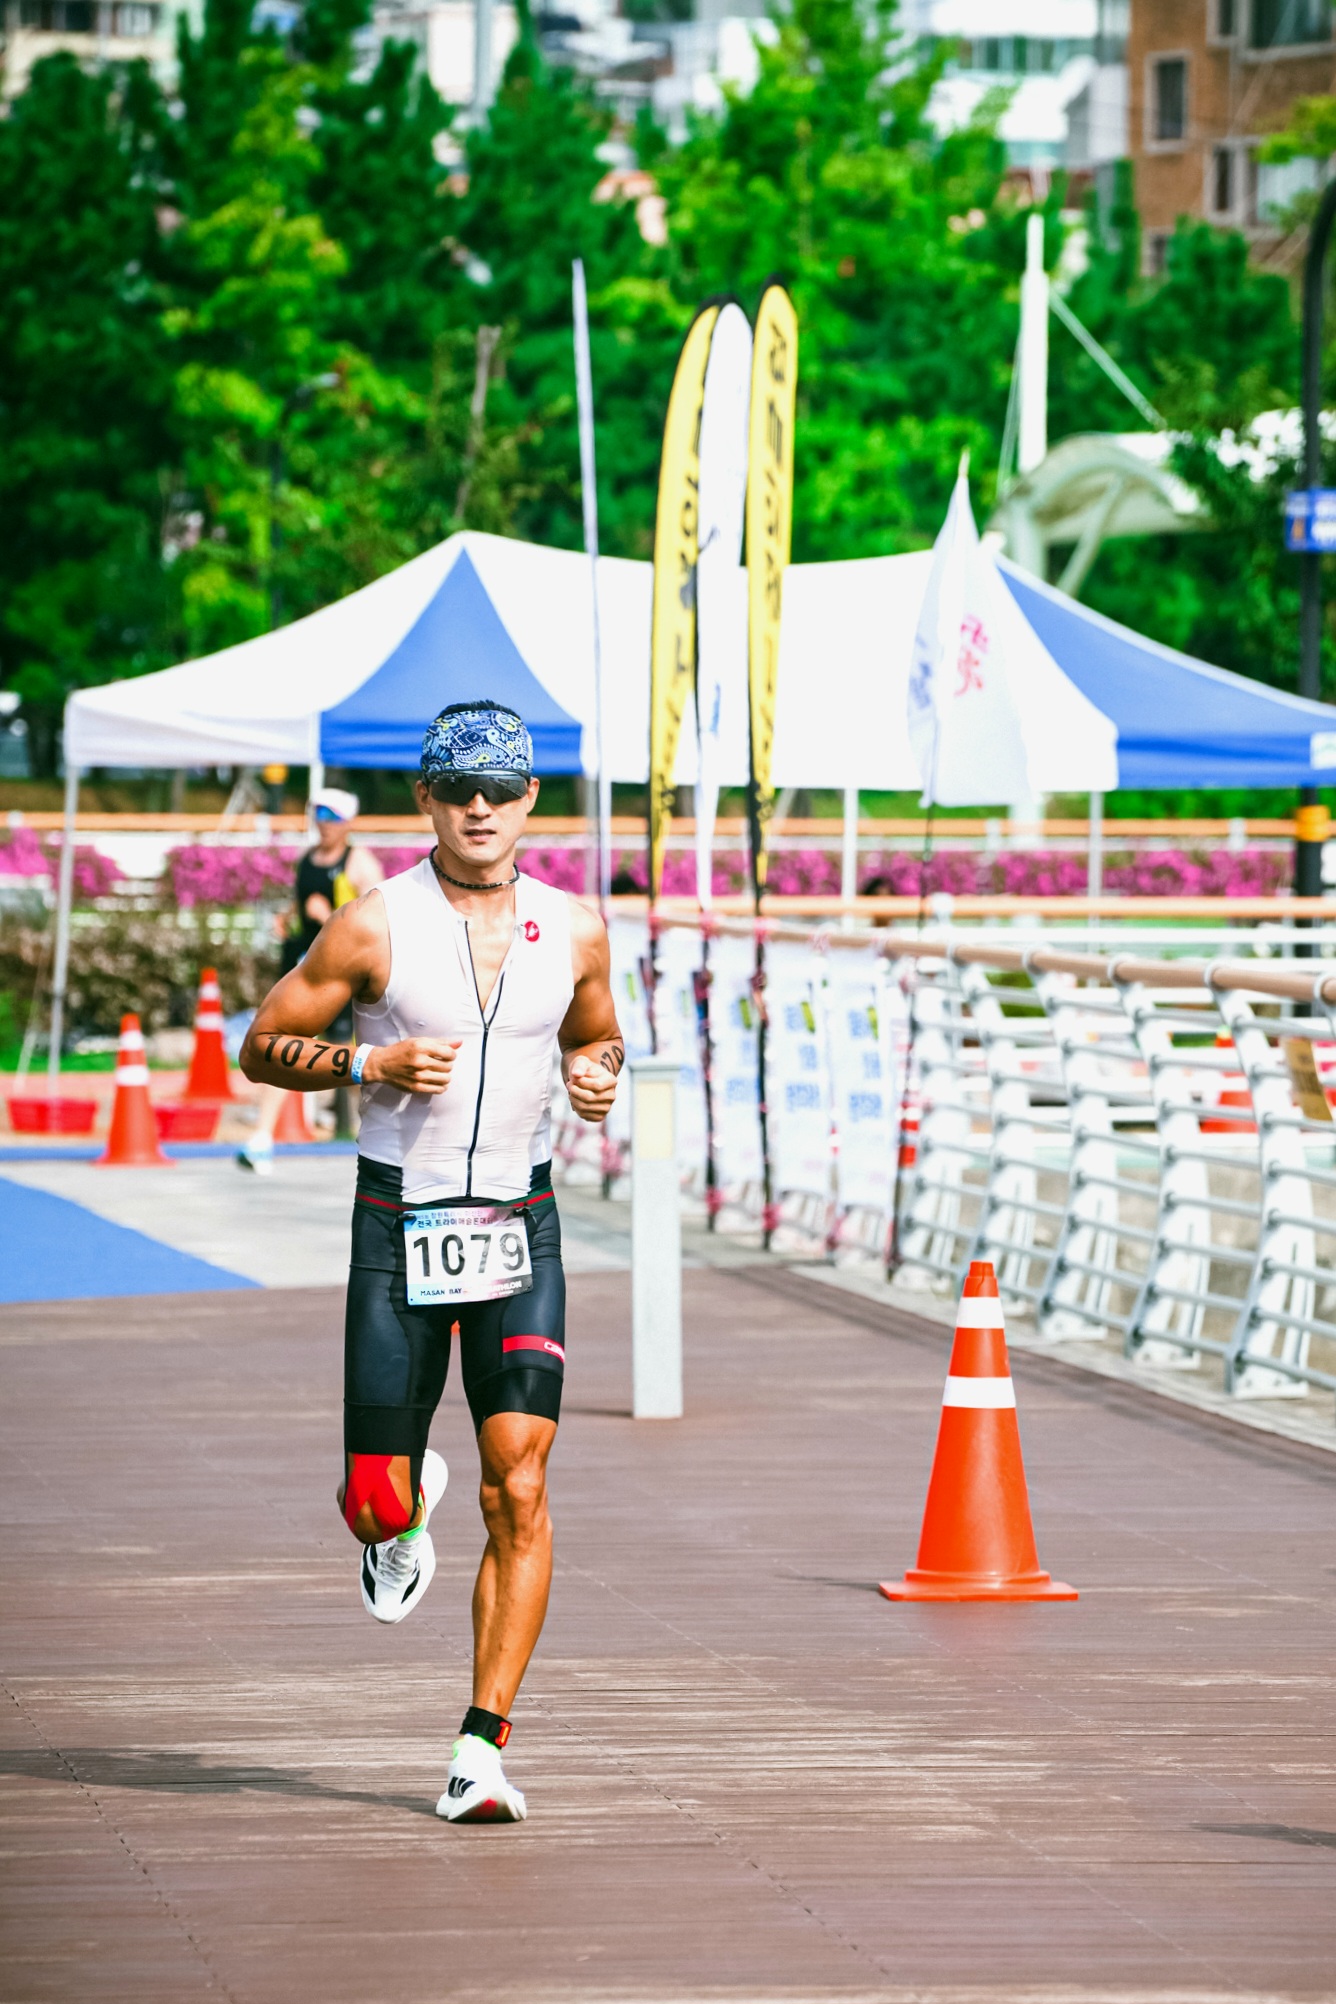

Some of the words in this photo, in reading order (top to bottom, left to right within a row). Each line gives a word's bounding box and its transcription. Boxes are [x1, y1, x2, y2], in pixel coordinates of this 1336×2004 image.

[264, 1035, 350, 1078] 1079
[417, 1219, 432, 1228] 전국
[413, 1232, 525, 1277] 1079
[420, 1289, 445, 1297] MASAN
[449, 1287, 463, 1295] BAY
